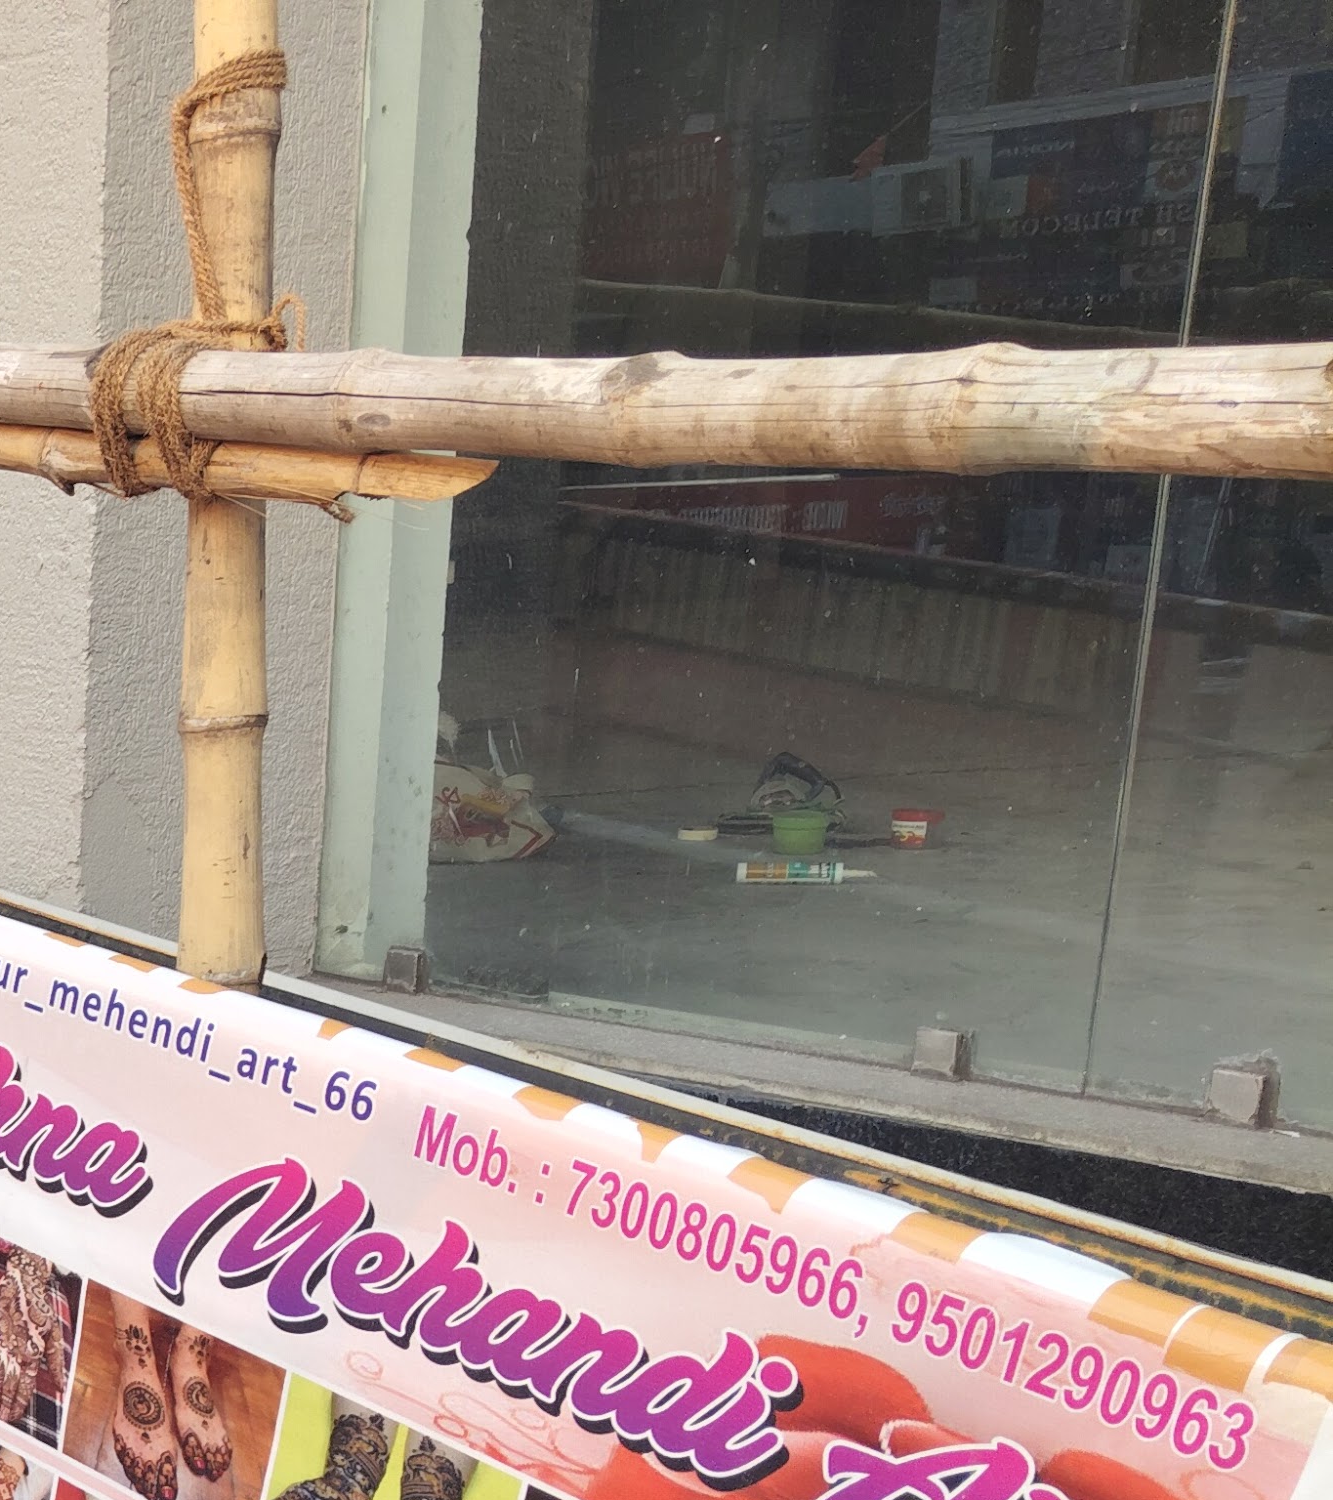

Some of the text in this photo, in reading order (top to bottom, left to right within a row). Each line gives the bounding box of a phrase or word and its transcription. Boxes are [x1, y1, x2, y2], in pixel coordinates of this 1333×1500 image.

[153, 1157, 799, 1486] Mehandi
[413, 1104, 518, 1194] Mob.
[566, 1158, 871, 1339] 7300805966,
[890, 1280, 1255, 1472] 9501290963
